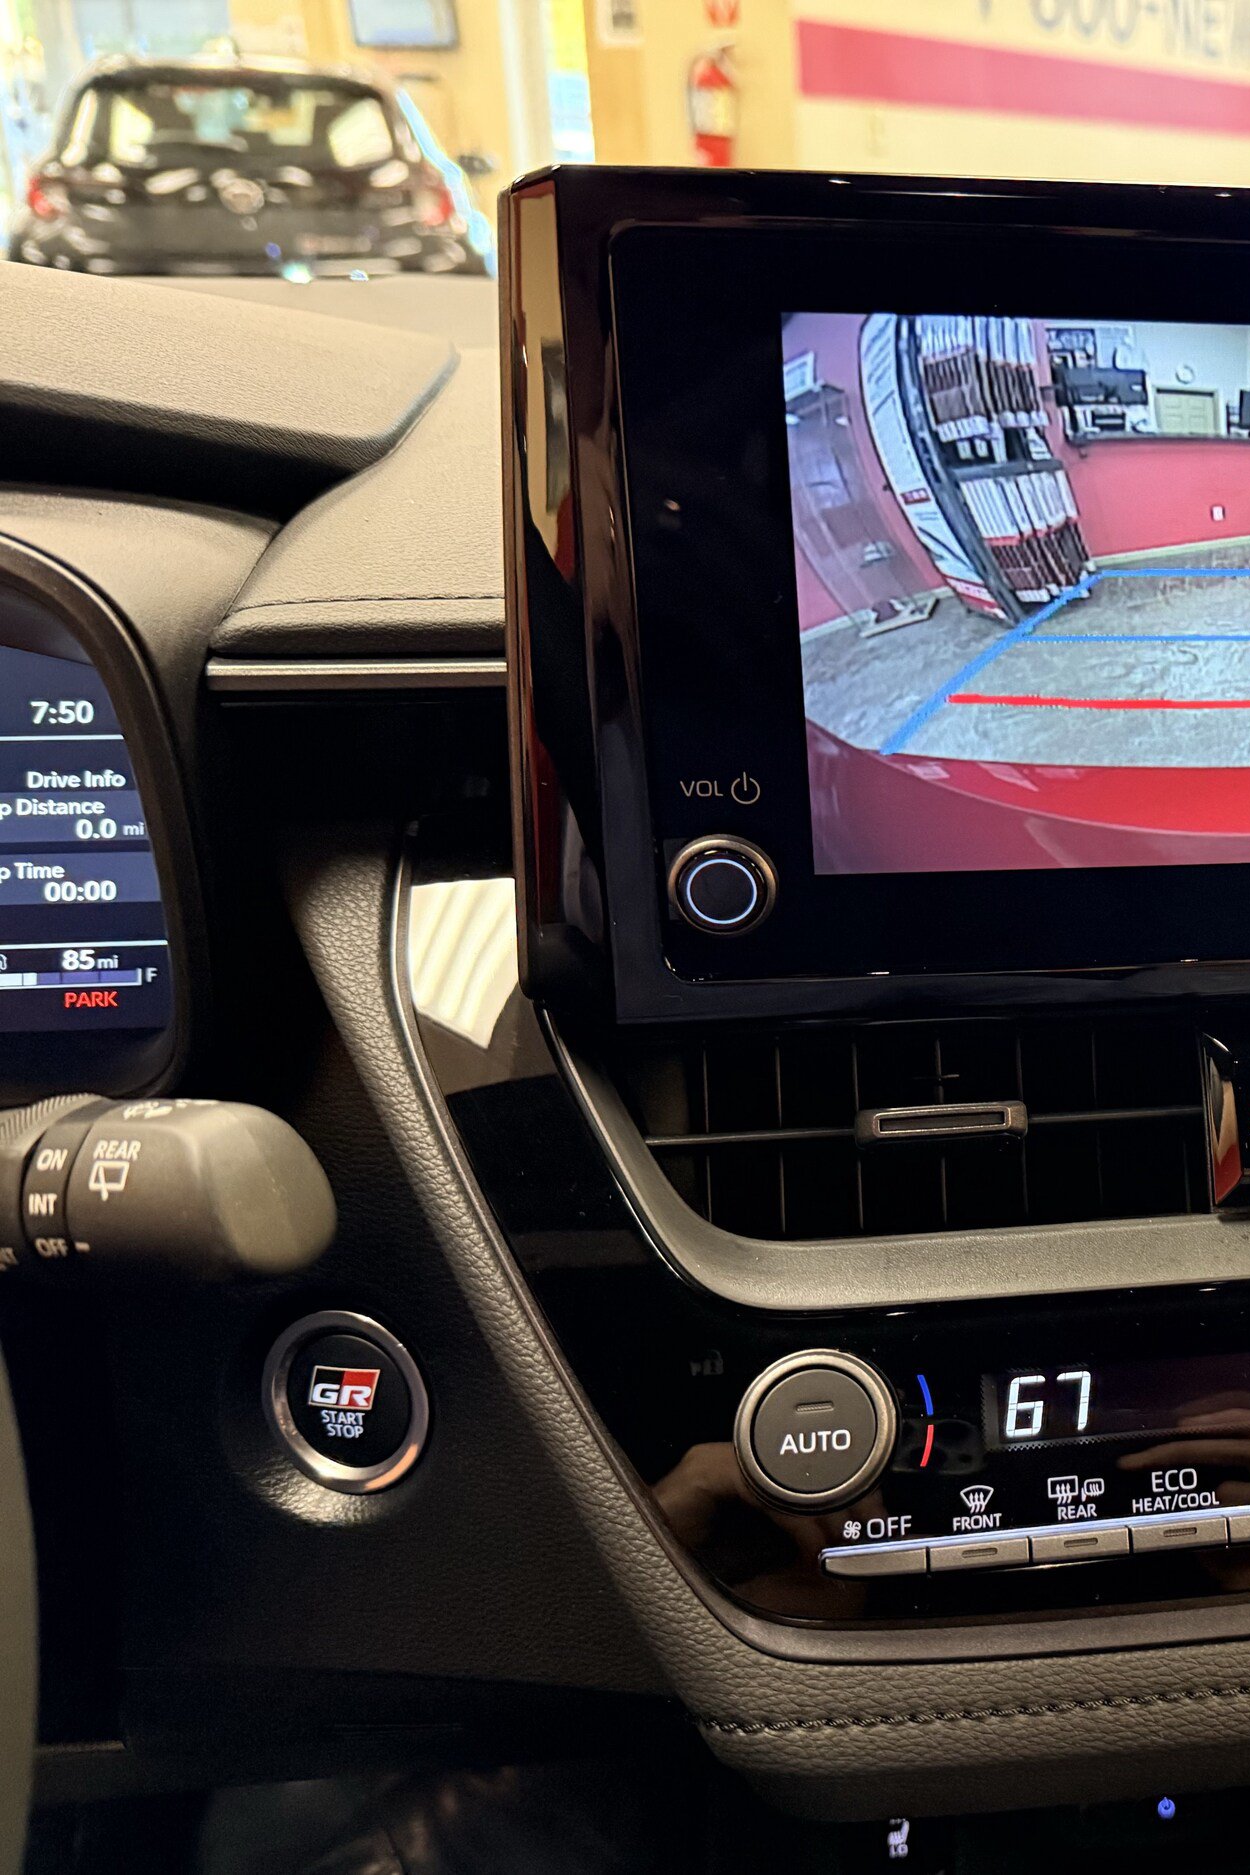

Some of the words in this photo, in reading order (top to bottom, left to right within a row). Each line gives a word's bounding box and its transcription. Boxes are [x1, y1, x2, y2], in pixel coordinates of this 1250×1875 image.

[30, 700, 94, 724] 7:50
[27, 771, 81, 788] Drive
[84, 769, 126, 787] Info
[679, 780, 724, 797] VOL
[16, 798, 105, 816] Distance
[75, 818, 117, 839] 0.0
[122, 821, 145, 836] mi
[14, 862, 65, 880] Time
[44, 880, 117, 901] 00:00
[62, 949, 95, 970] 85
[97, 955, 119, 969] mi
[145, 968, 158, 983] F
[64, 991, 118, 1008] PARK
[36, 1148, 68, 1171] ON
[93, 1140, 141, 1161] REAR
[28, 1192, 58, 1217] INT
[35, 1237, 69, 1257] OFF
[312, 1383, 372, 1407] GR
[1006, 1371, 1092, 1438] 67
[321, 1410, 365, 1425] START
[327, 1424, 364, 1439] STOP
[779, 1429, 851, 1455] AUTO
[1151, 1468, 1198, 1492] ECO
[1057, 1503, 1097, 1520] REAR
[1132, 1492, 1220, 1512] HEAT/COOL
[866, 1515, 912, 1540] OFF
[953, 1512, 1002, 1531] FRONT
